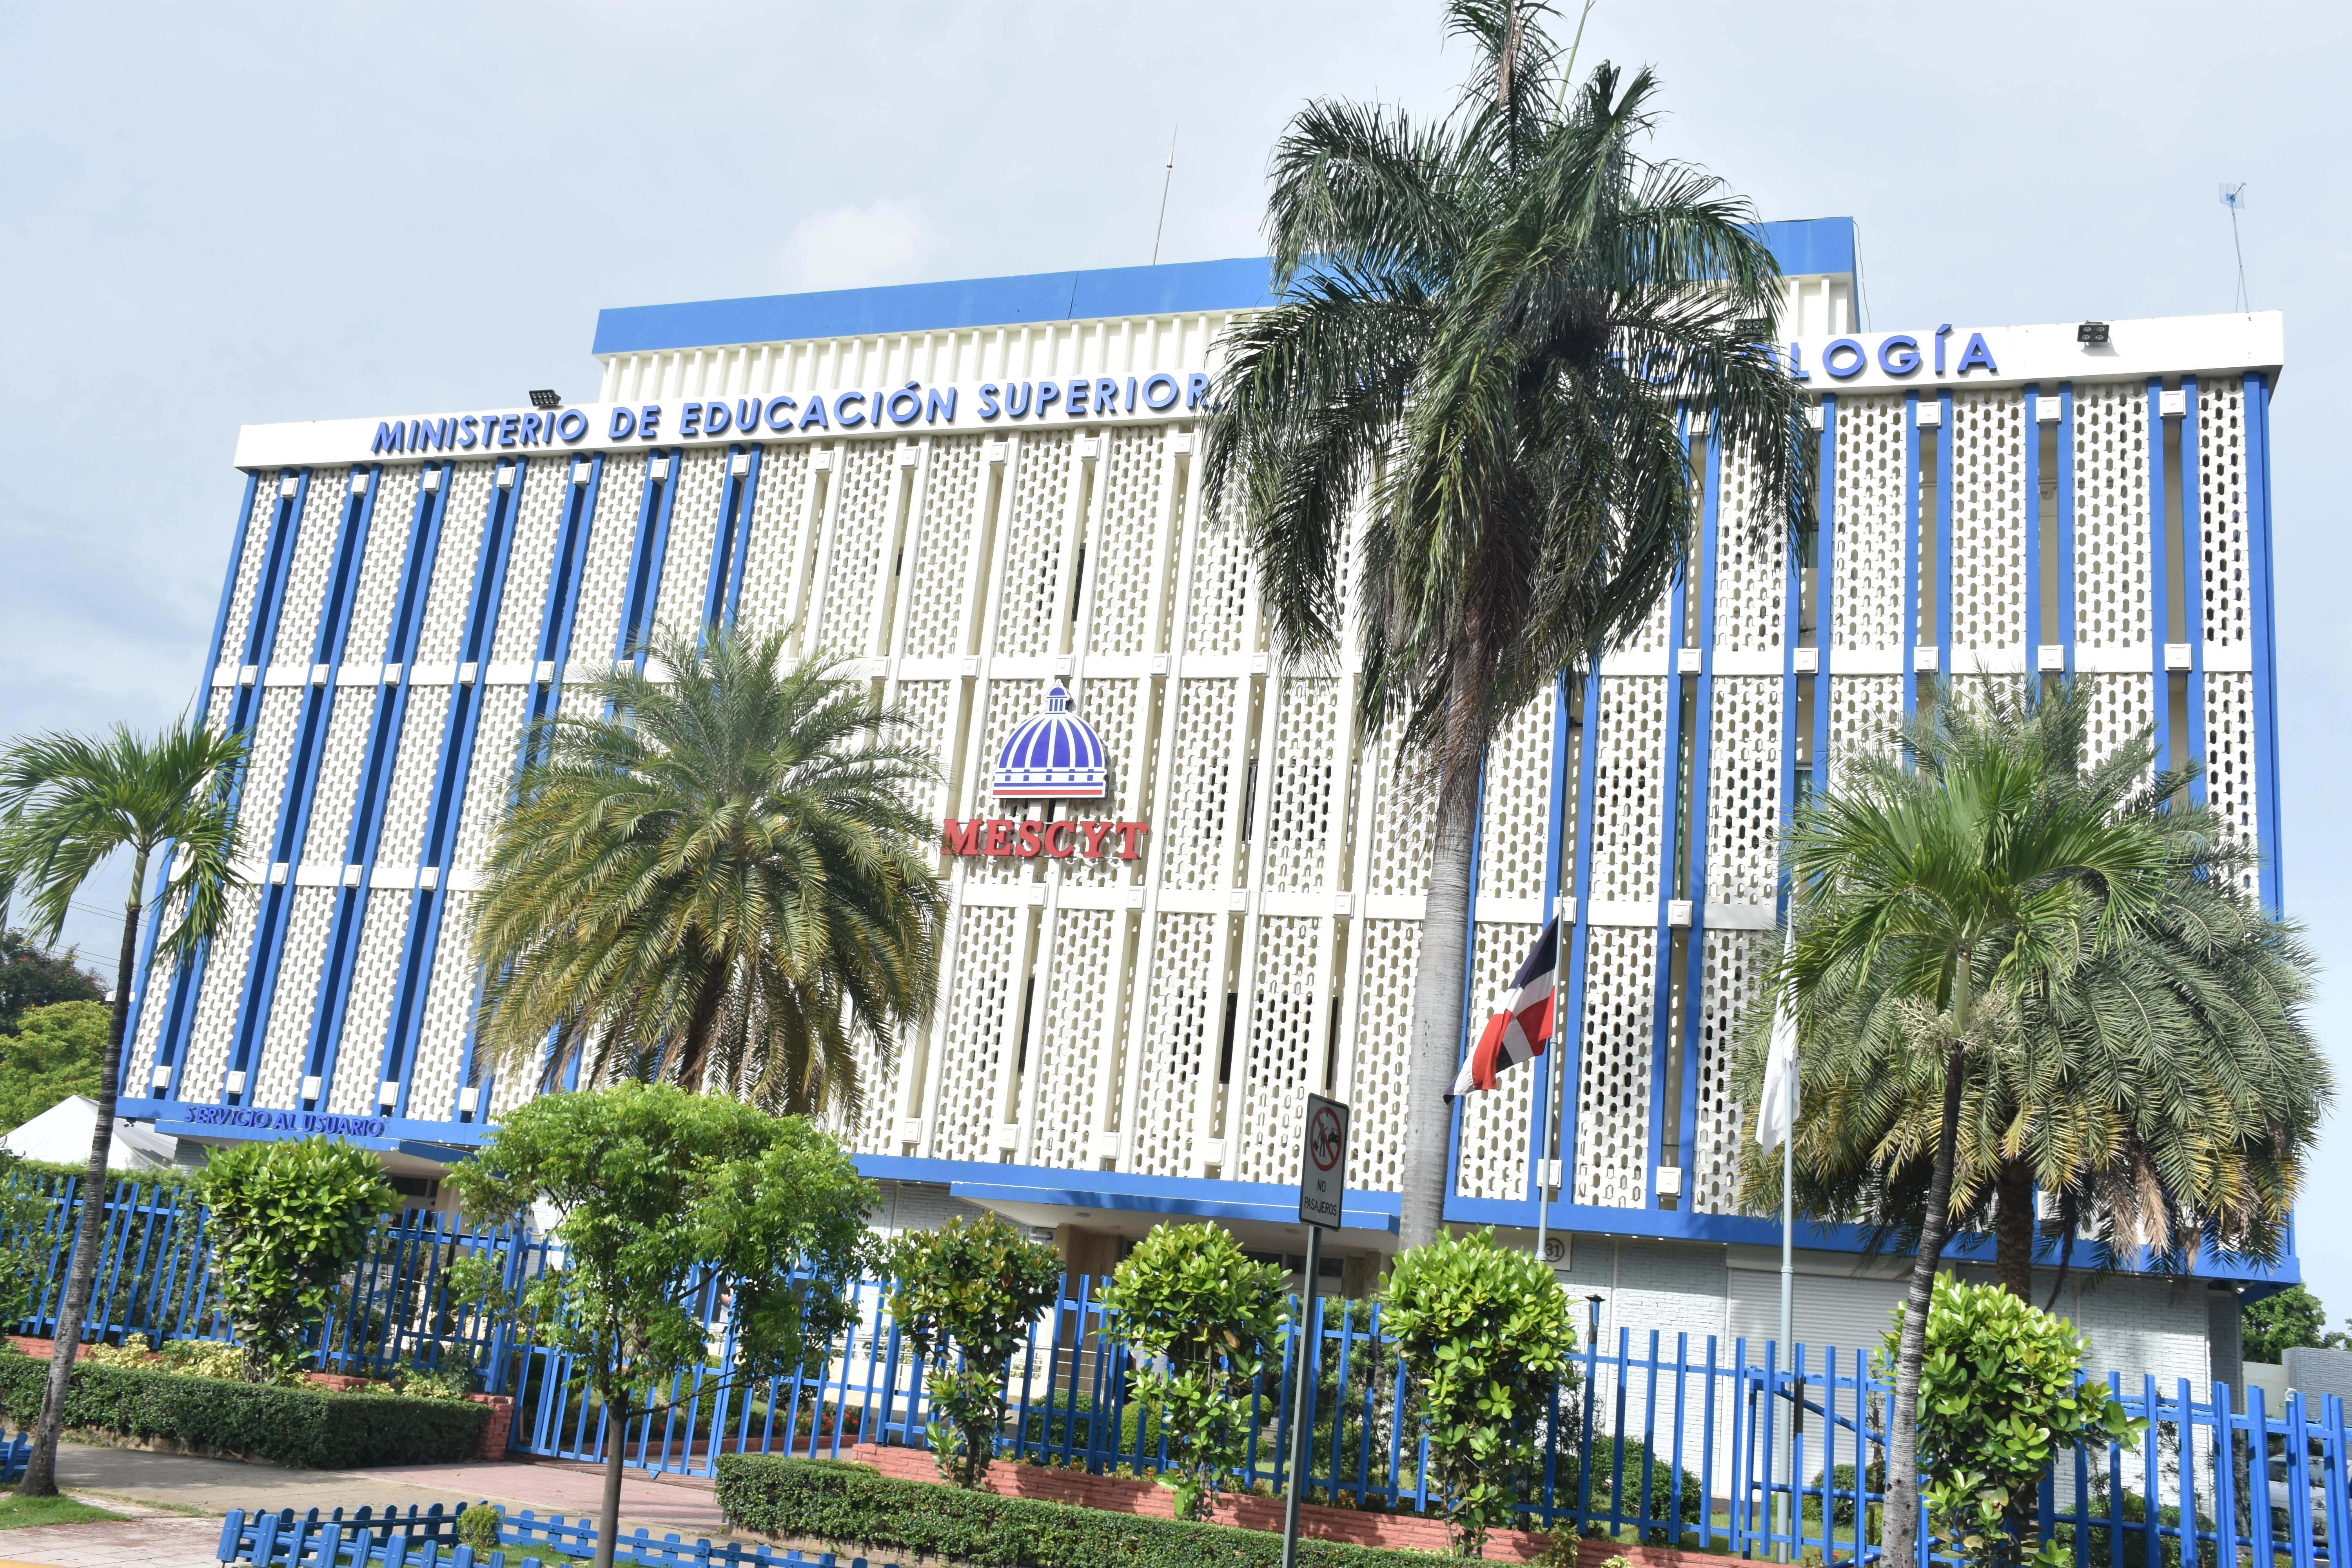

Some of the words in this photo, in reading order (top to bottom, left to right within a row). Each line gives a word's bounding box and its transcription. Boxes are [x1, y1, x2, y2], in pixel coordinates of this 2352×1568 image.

[370, 409, 588, 453] MINISTERIO
[608, 405, 661, 441] DE
[679, 381, 958, 434] EDUCACIÓN
[940, 818, 1148, 859] MESCYT
[184, 1105, 272, 1128] SERVICIO
[273, 1112, 296, 1131] AL
[302, 1114, 385, 1137] USUARIO
[1317, 1179, 1326, 1192] NO
[1304, 1196, 1337, 1216] PASAJEROS
